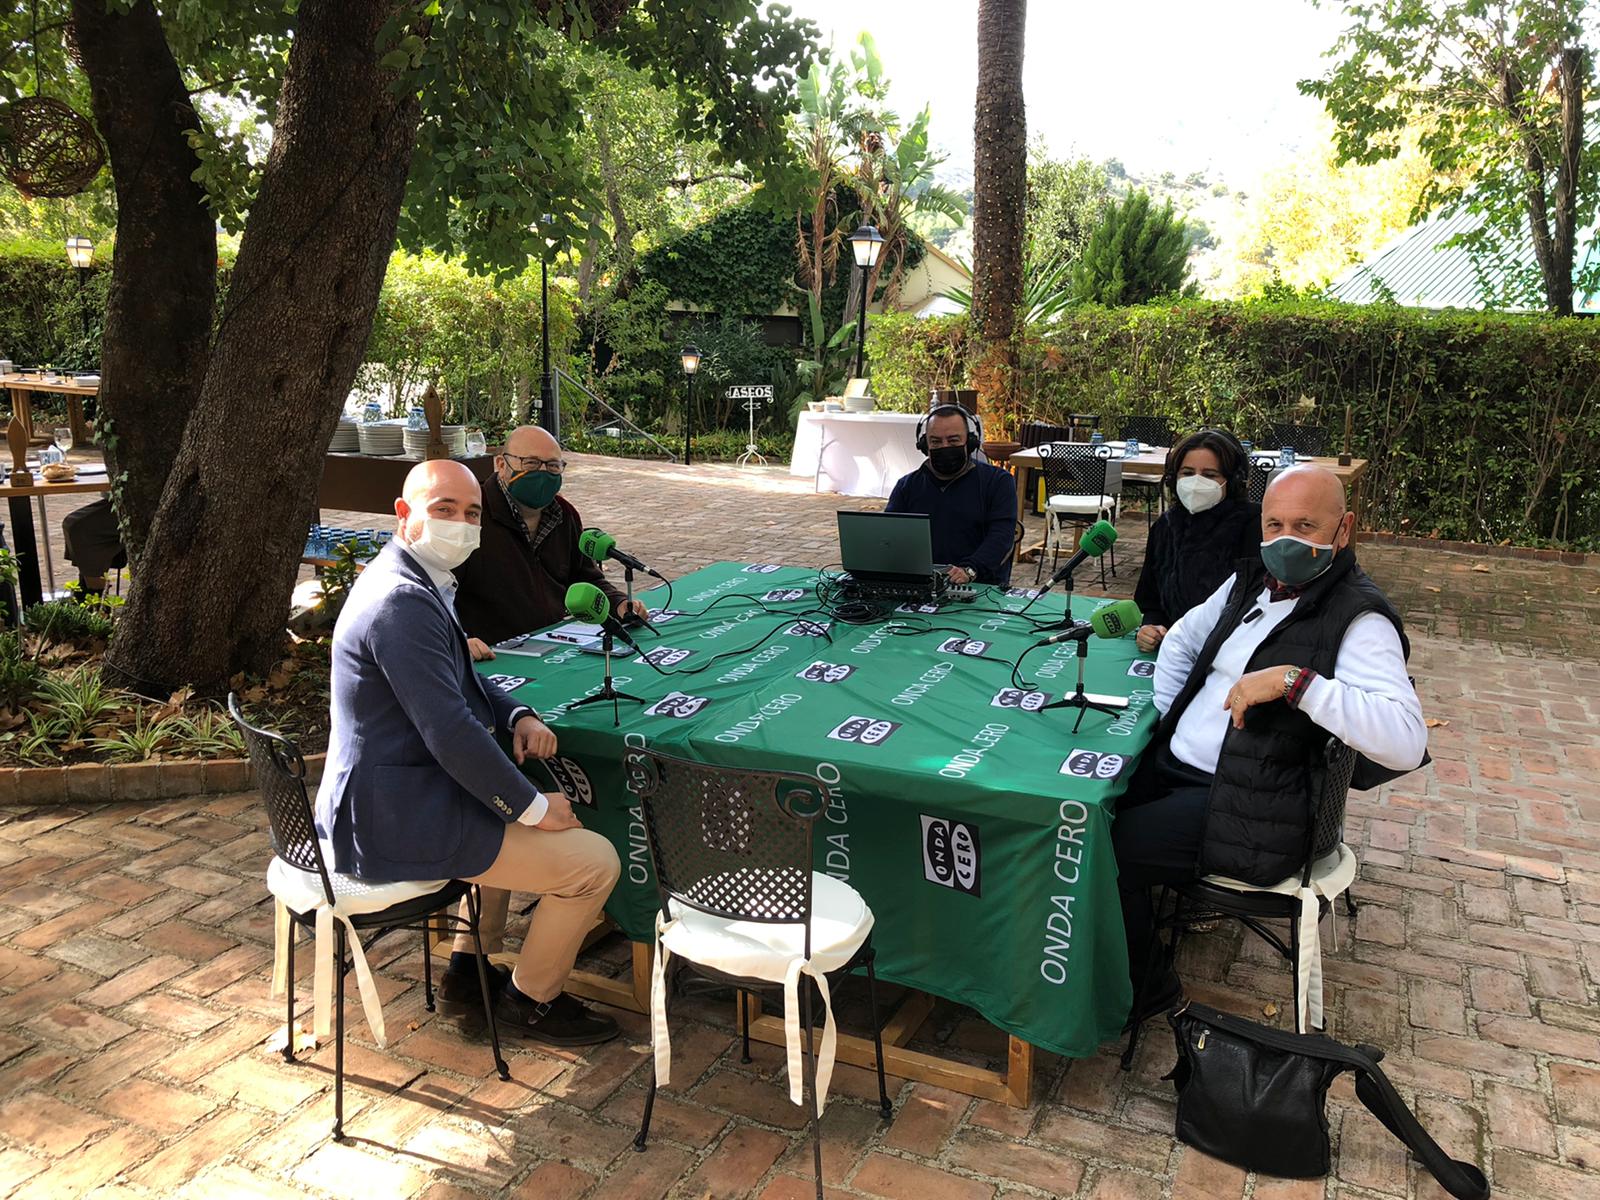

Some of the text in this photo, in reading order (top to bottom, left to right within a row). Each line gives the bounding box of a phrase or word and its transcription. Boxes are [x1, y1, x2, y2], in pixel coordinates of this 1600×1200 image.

[732, 387, 772, 397] ASEOS
[717, 645, 789, 684] ONDA CERO
[891, 662, 954, 705] ONDA CERO
[715, 694, 803, 743] ONDA CERO
[840, 719, 869, 738] ONDA
[863, 722, 890, 741] CERO
[939, 723, 1010, 778] ONDA CERO
[1073, 754, 1095, 774] ONDA
[1098, 757, 1120, 775] CERO
[628, 806, 649, 884] ONDA
[933, 825, 948, 876] ONDA
[957, 831, 971, 880] CERO
[1040, 800, 1088, 985] ONDA CERO
